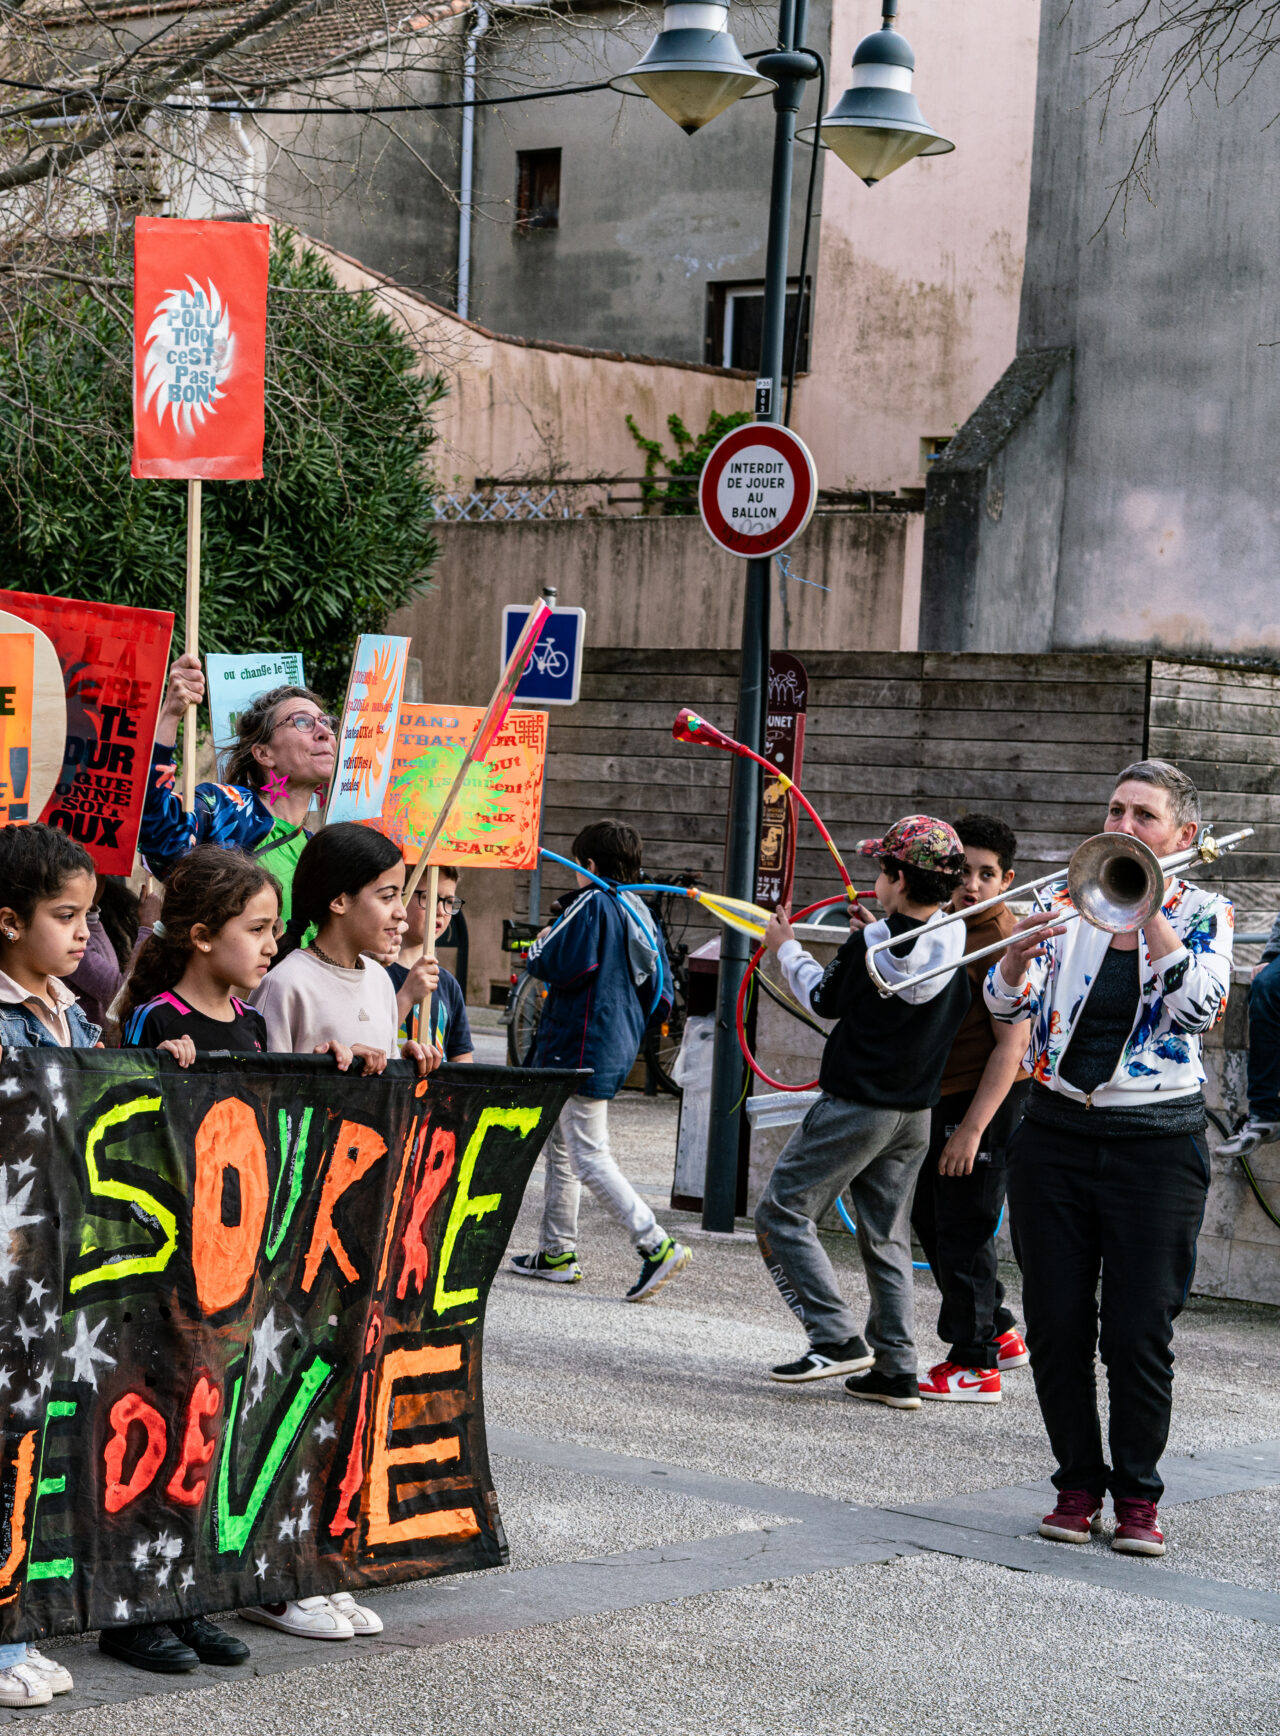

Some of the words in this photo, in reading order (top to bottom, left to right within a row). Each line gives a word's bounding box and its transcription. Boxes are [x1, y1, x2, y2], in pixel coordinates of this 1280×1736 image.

[180, 291, 204, 308] LA
[167, 309, 221, 328] POLU
[175, 366, 210, 385] Pas
[730, 463, 784, 474] INTERDIT
[727, 478, 742, 489] DE
[746, 477, 785, 489] JOUER
[747, 492, 763, 503] AU
[732, 507, 776, 518] BALLON
[81, 635, 137, 678] LA
[224, 670, 236, 681] ou
[240, 664, 272, 681] change
[274, 663, 282, 674] le
[74, 772, 133, 793] QUE
[55, 783, 132, 807] ONNE
[103, 1375, 220, 1514] DE
[216, 1313, 481, 1555] VIE
